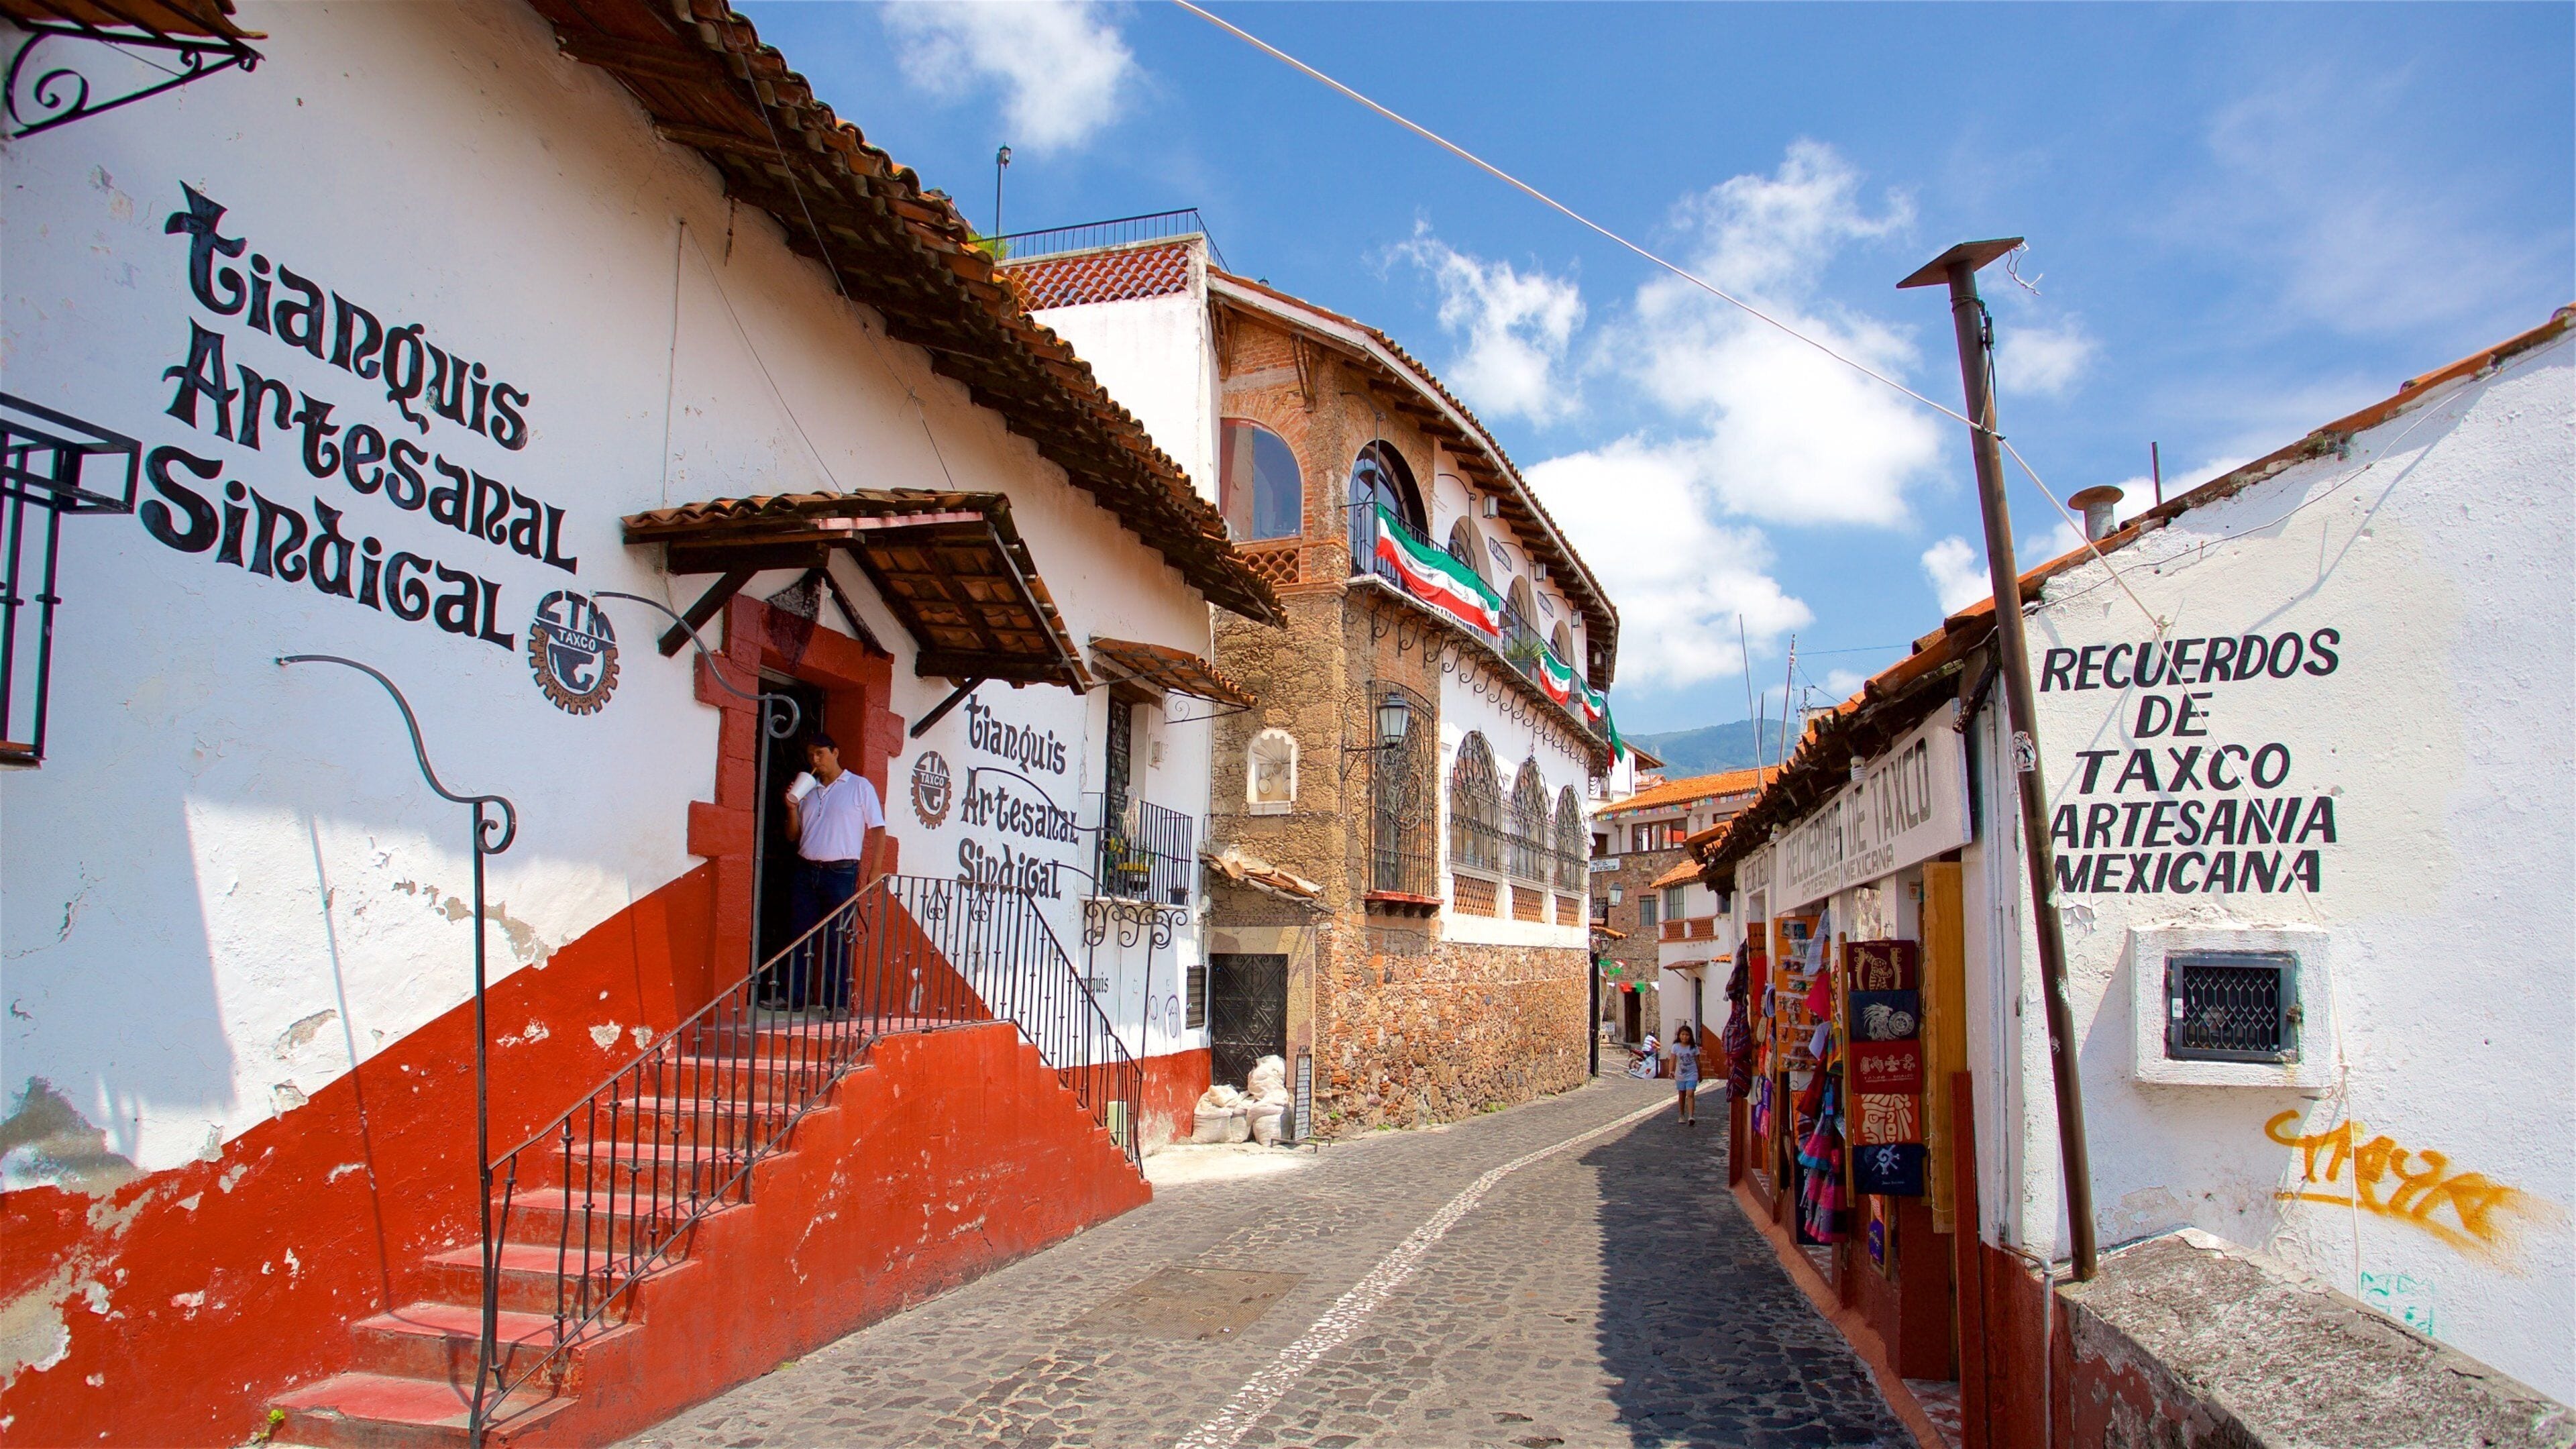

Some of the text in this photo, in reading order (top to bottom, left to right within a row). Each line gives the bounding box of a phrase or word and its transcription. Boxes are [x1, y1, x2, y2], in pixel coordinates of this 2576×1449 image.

[557, 629, 596, 651] TAXCO
[2039, 627, 2340, 692] RECUERDOS
[2133, 692, 2213, 739] DE
[920, 772, 945, 786] TAXCO
[2076, 743, 2290, 795] TAXCO
[1786, 800, 1841, 889] RECUERDOS
[1846, 784, 1867, 857] DE
[1870, 737, 1931, 845] TAXCO
[2051, 796, 2337, 849] ARTESANIA
[1802, 867, 1839, 900] ARTESANIA
[1843, 843, 1894, 882] MEXICANA
[2055, 849, 2320, 894] MEXICANA
